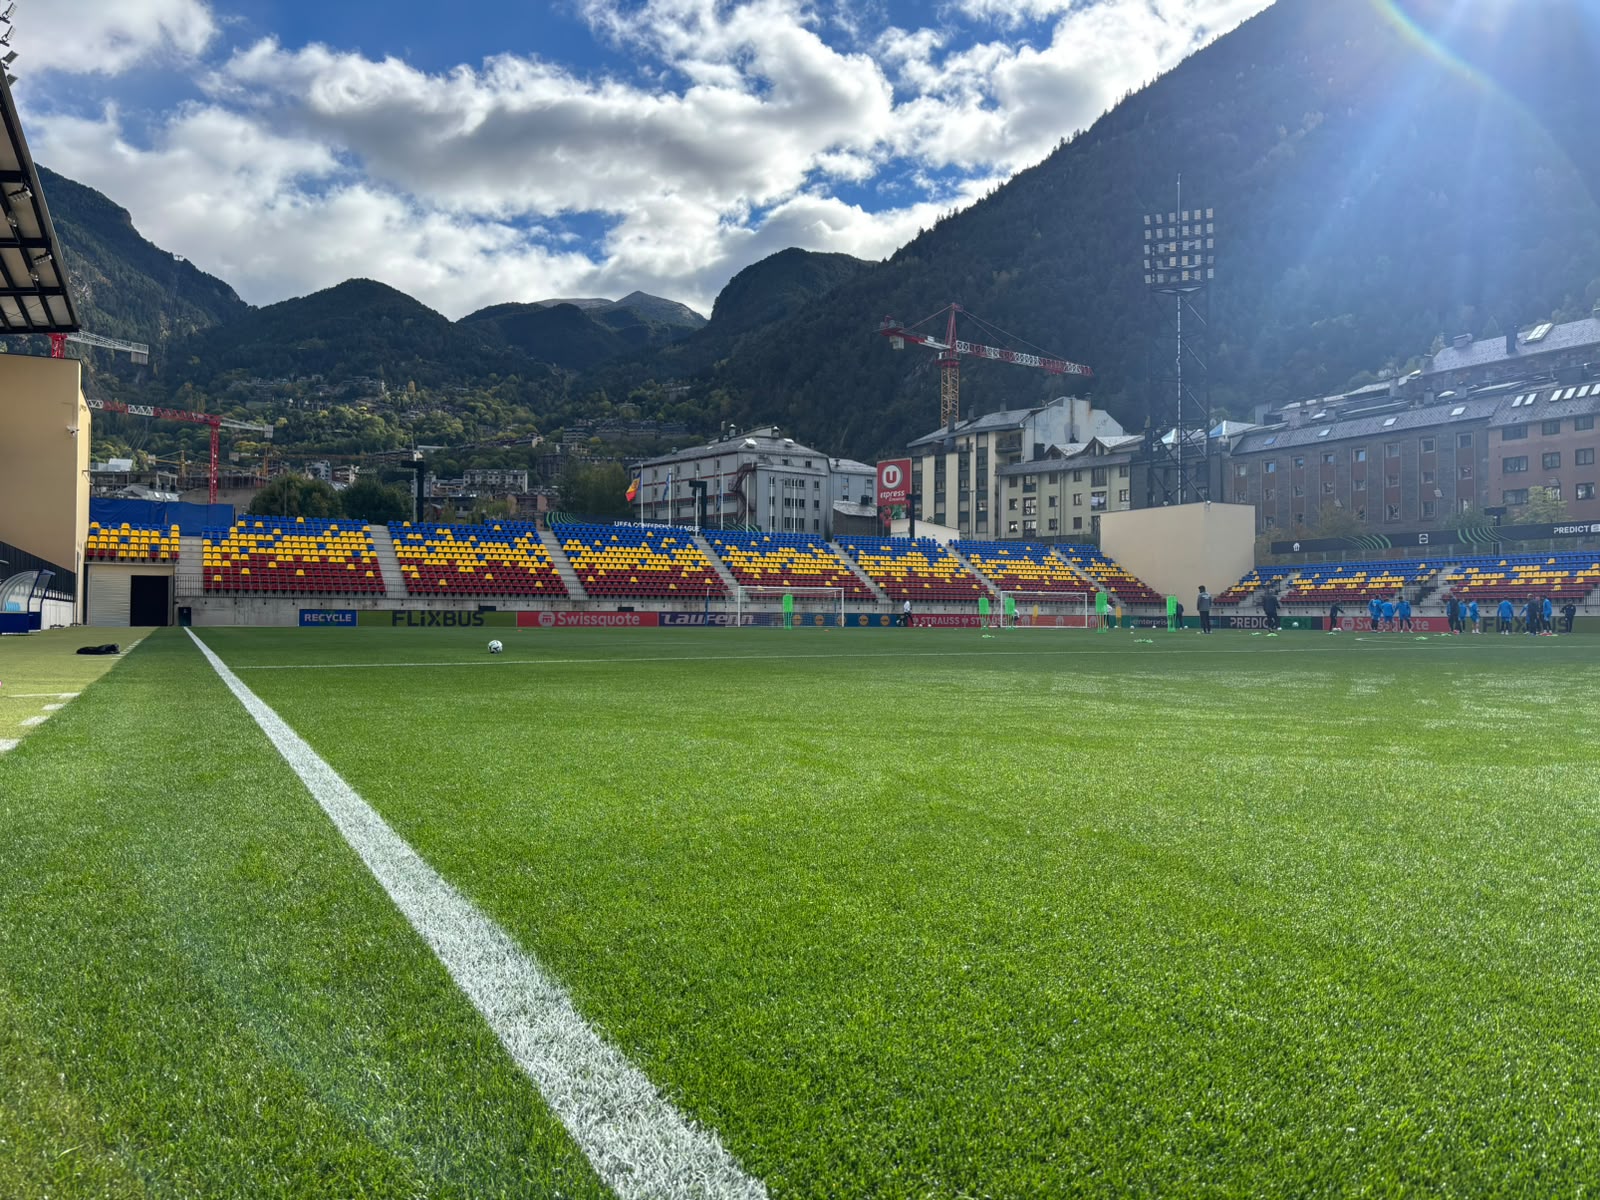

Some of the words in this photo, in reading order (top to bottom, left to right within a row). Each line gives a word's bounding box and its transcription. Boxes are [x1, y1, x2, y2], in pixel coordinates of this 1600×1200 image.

[614, 520, 632, 528] UEFA
[1553, 525, 1590, 534] PREDICT
[304, 613, 352, 622] RECYCLE
[557, 611, 640, 627] Swissquote
[920, 616, 960, 625] STRAUSS
[1133, 618, 1169, 626] enterpris
[1230, 617, 1274, 628] PREDIC
